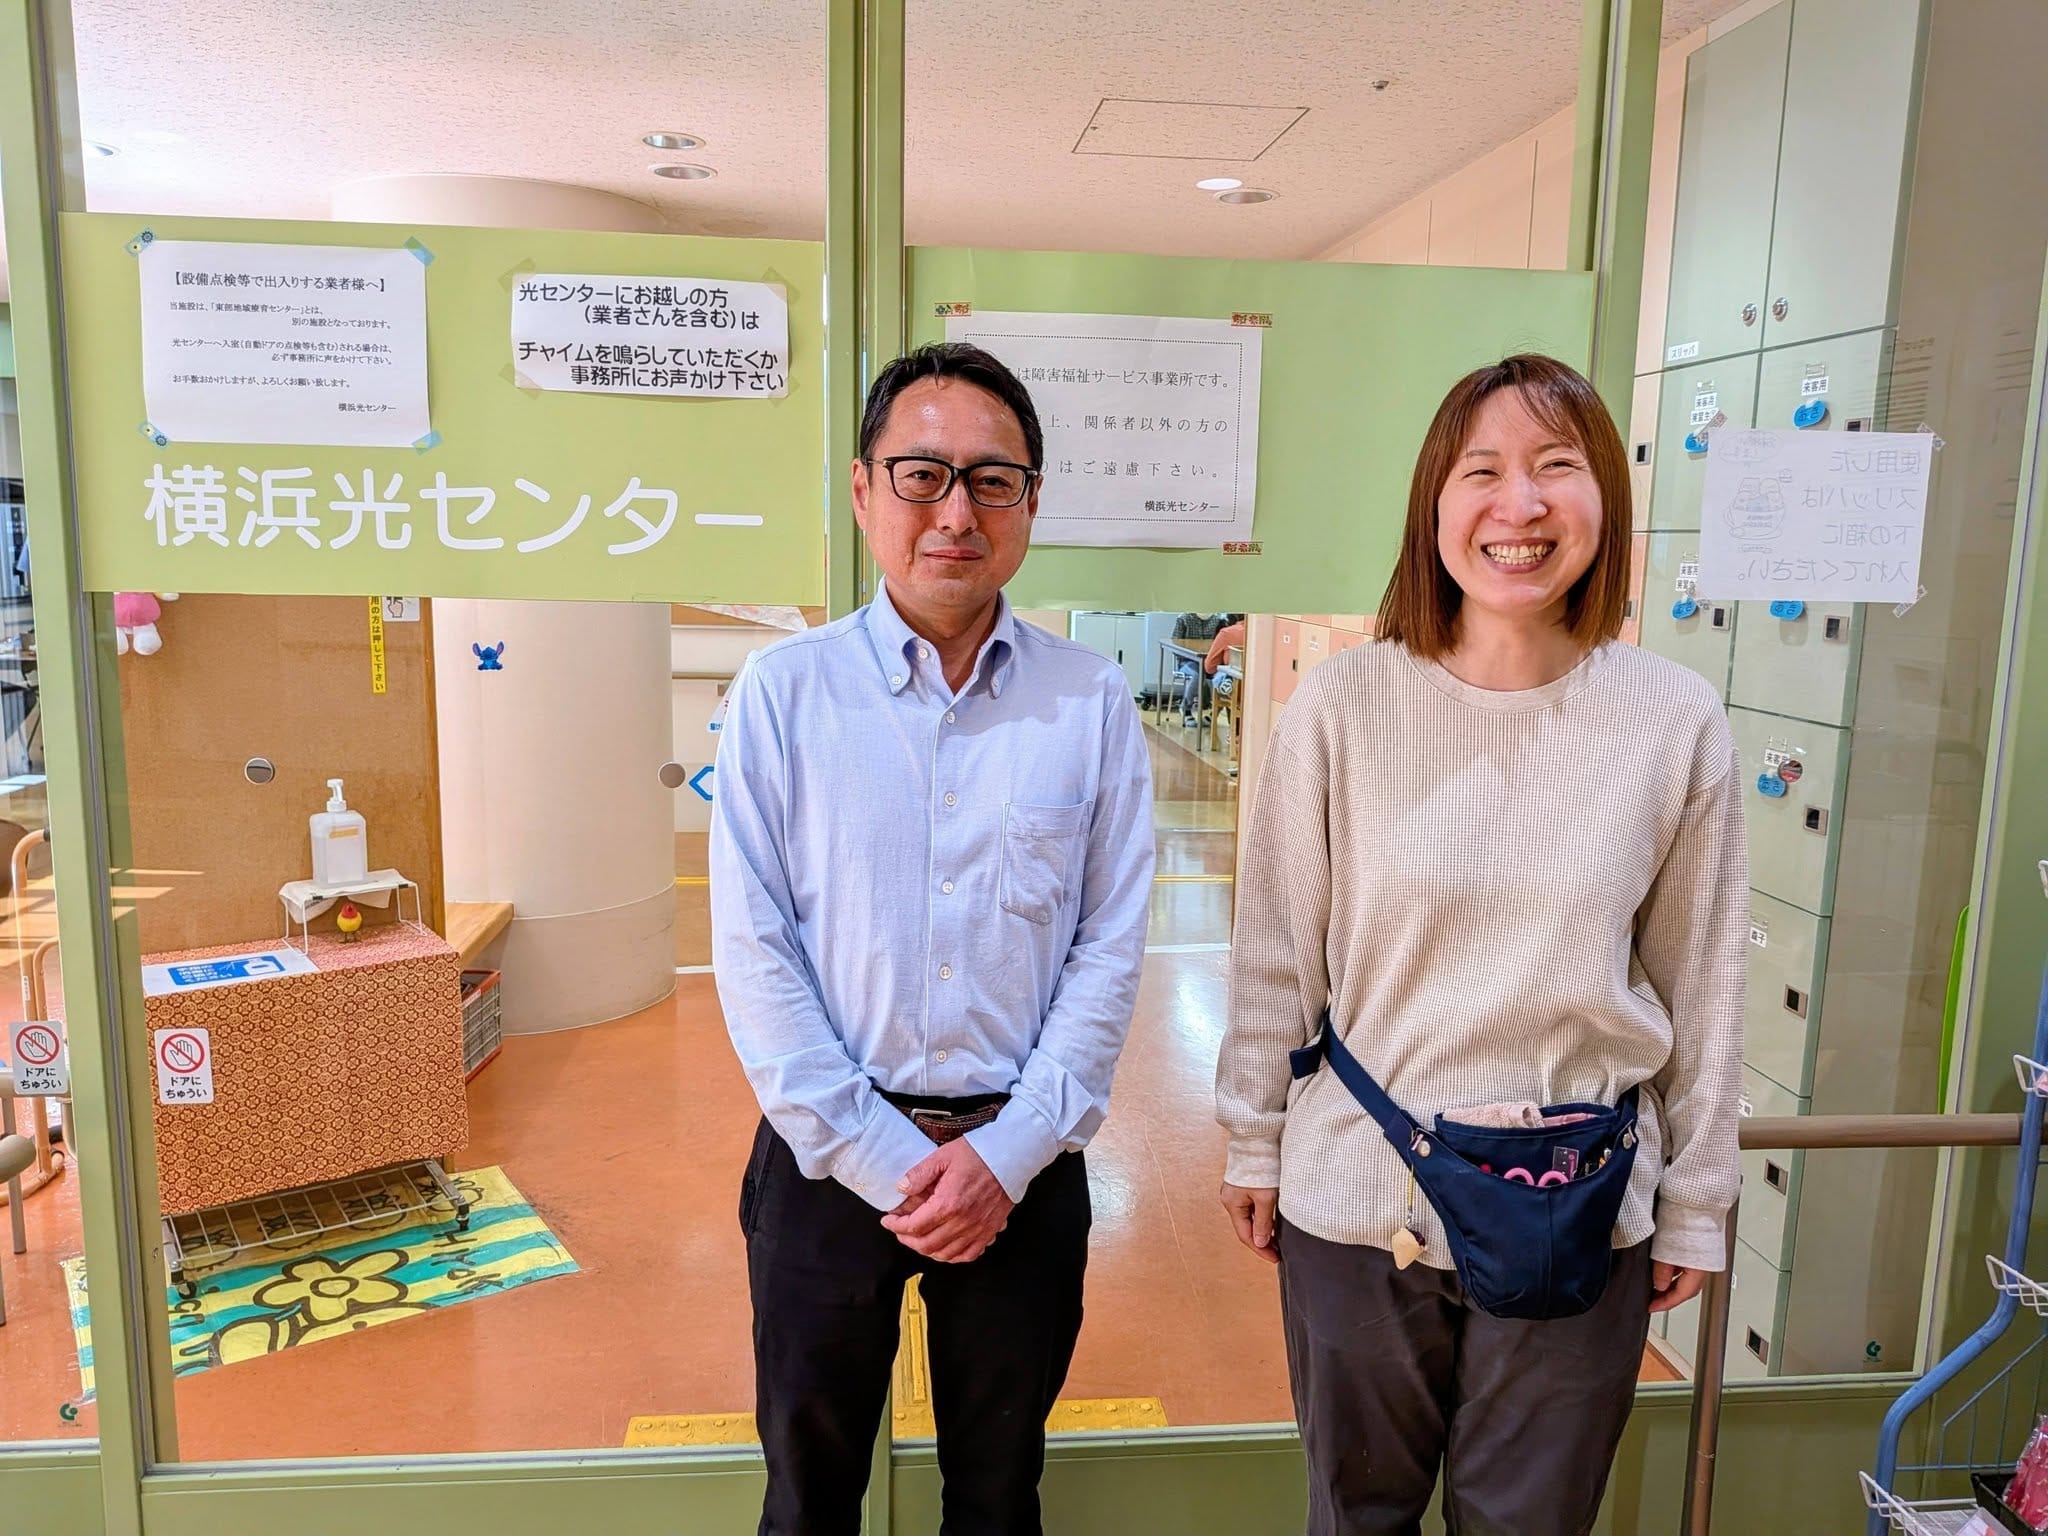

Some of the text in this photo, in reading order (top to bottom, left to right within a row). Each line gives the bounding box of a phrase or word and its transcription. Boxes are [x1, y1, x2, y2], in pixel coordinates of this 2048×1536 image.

[174, 270, 385, 293] 【設備点検等で出入りする業者様へ】
[518, 283, 729, 308] 光センターにお越しの方
[584, 304, 760, 330] (業者さんを含む)は
[518, 340, 778, 370] チャイムを鳴らしていただくか
[570, 364, 784, 391] 事務所にお声かけ下さい
[1007, 366, 1228, 389] は障害福祉サービス事業所です。
[338, 402, 397, 413] 横浜光センター
[1037, 414, 1228, 433] 上、関係者以外の方の
[145, 463, 763, 555] 横浜光センター
[1144, 500, 1220, 513] 横浜光センター
[25, 1066, 56, 1077] ドアに
[170, 1075, 202, 1086] ドアに
[20, 1078, 62, 1090] ちゅうい
[165, 1087, 208, 1099] ちゅうい
